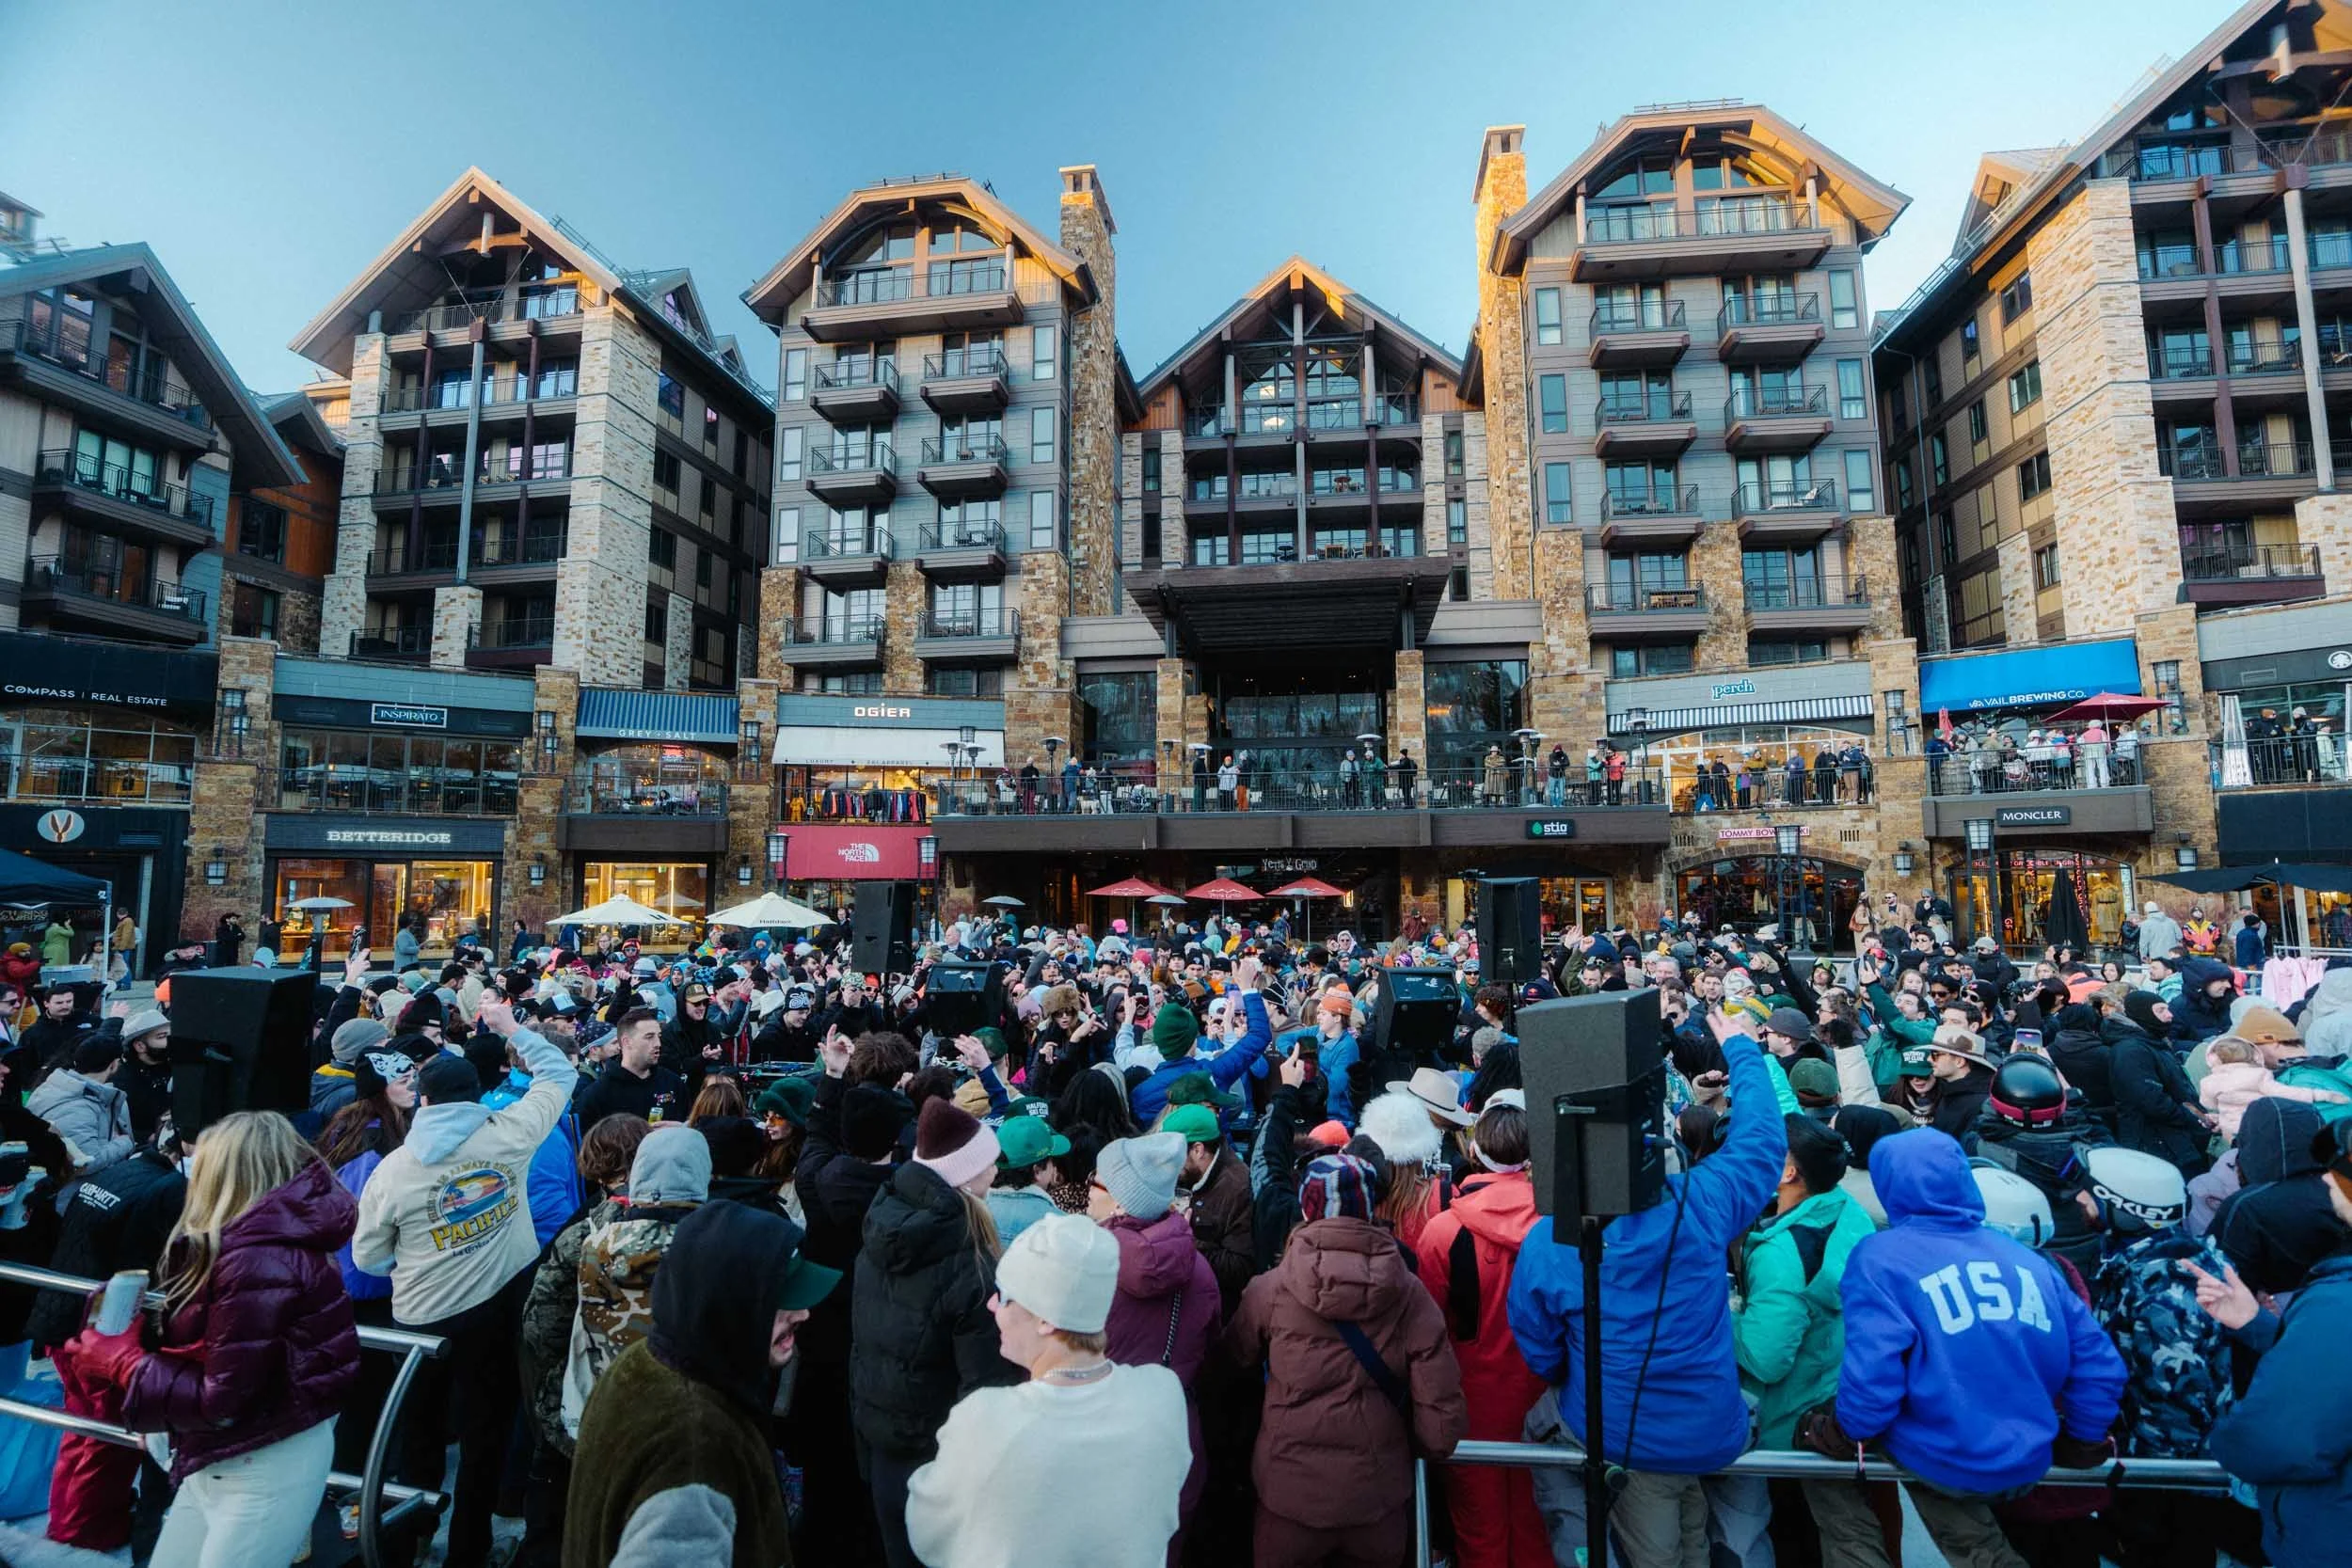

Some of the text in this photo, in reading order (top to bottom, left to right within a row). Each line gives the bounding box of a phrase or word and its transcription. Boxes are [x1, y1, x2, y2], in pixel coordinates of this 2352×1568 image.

[4, 684, 167, 706] COMPASS REAL ESTATE
[1712, 678, 1755, 699] perch
[381, 709, 437, 721] INSPIRATO
[618, 729, 651, 737] GREY
[2002, 811, 2062, 821] MONCLER
[1544, 822, 1567, 832] stio
[326, 831, 451, 844] BETTERIDGE
[2092, 1185, 2173, 1220] OAKLEY
[1918, 1261, 2052, 1335] USA
